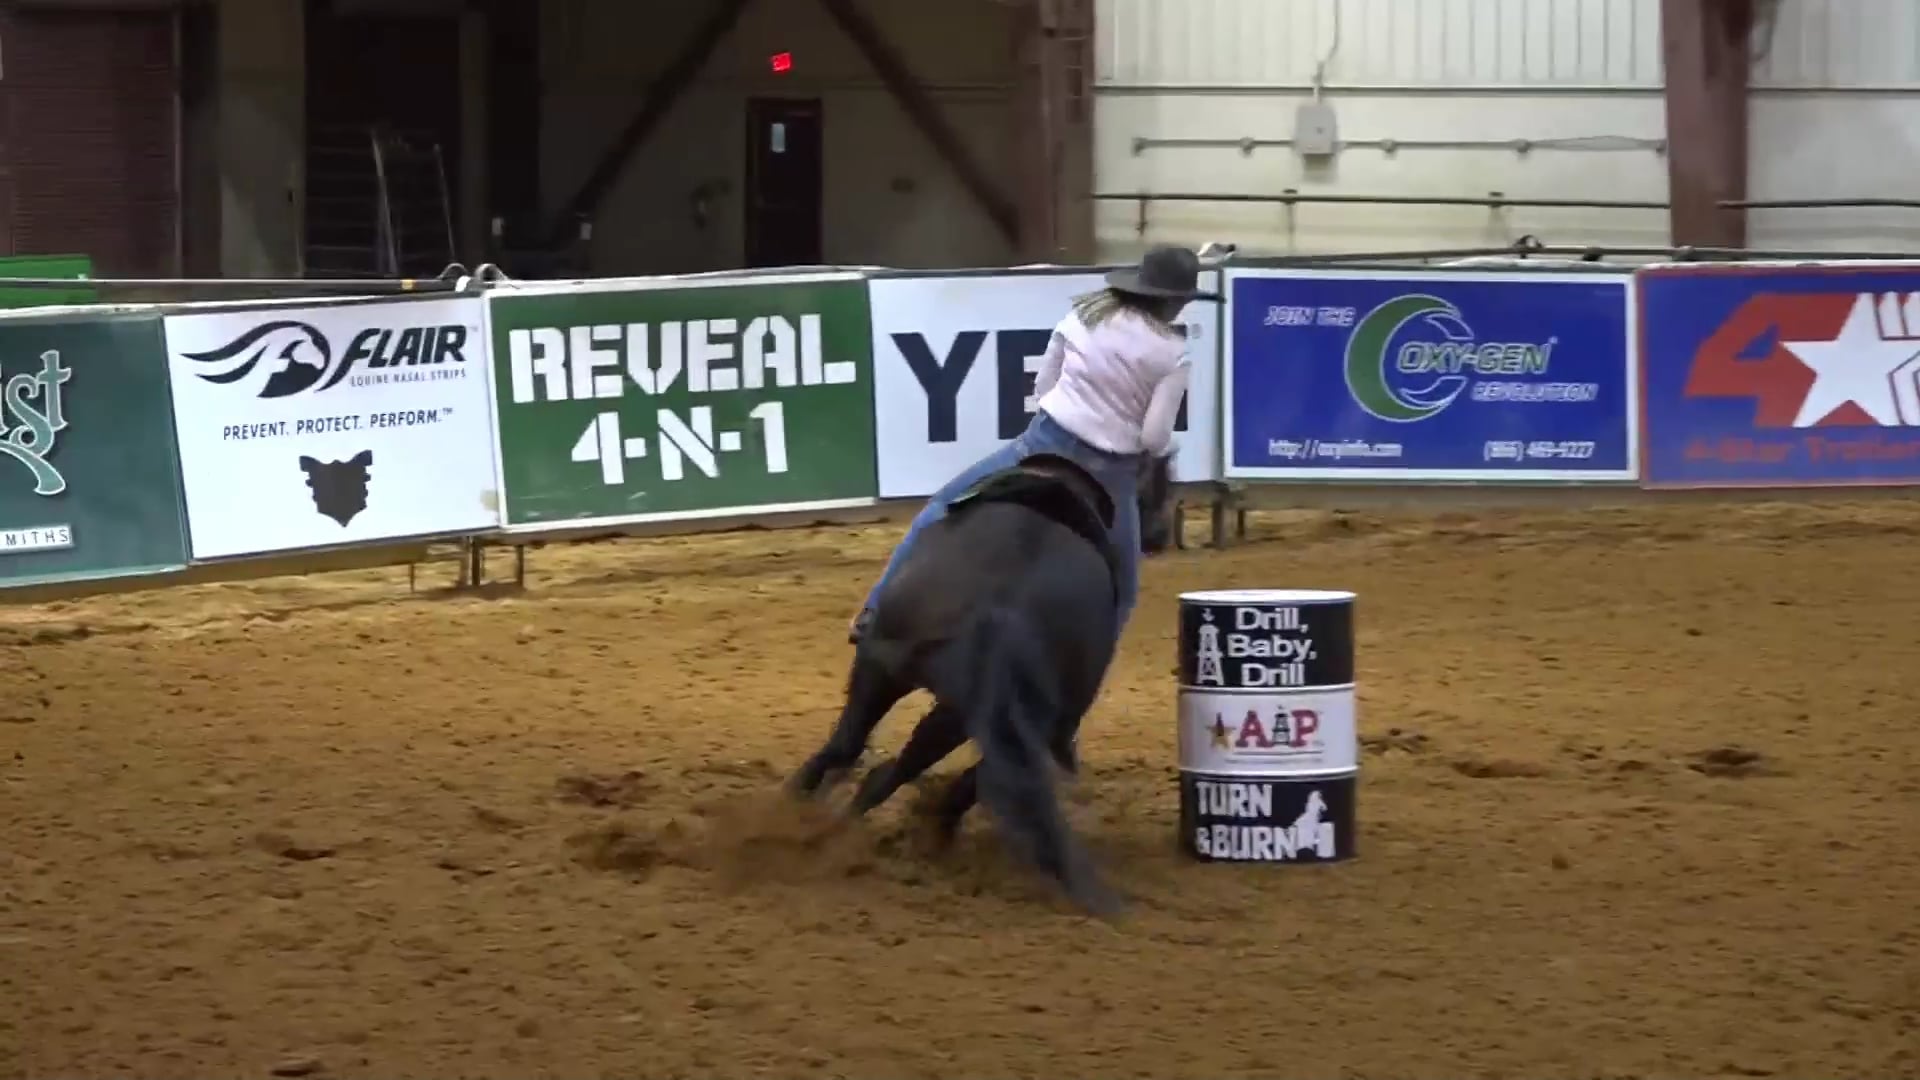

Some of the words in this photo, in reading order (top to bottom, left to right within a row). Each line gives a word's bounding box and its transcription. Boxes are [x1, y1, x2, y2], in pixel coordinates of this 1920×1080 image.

[1264, 306, 1314, 326] JOIN
[313, 325, 467, 393] FLAIR
[509, 314, 856, 403] REVEAL
[1396, 341, 1552, 375] OXY-GEN
[351, 373, 388, 387] EQUINE
[394, 371, 425, 383] NASAL
[431, 368, 466, 381] STRIPS
[223, 421, 289, 440] PREVENT.
[296, 415, 363, 434] PROTECT.
[571, 401, 788, 485] 4-N-1
[1235, 607, 1309, 633] Drill,
[1226, 634, 1317, 661] Baby,
[1241, 664, 1305, 686] Drill
[1196, 782, 1272, 817] TURN
